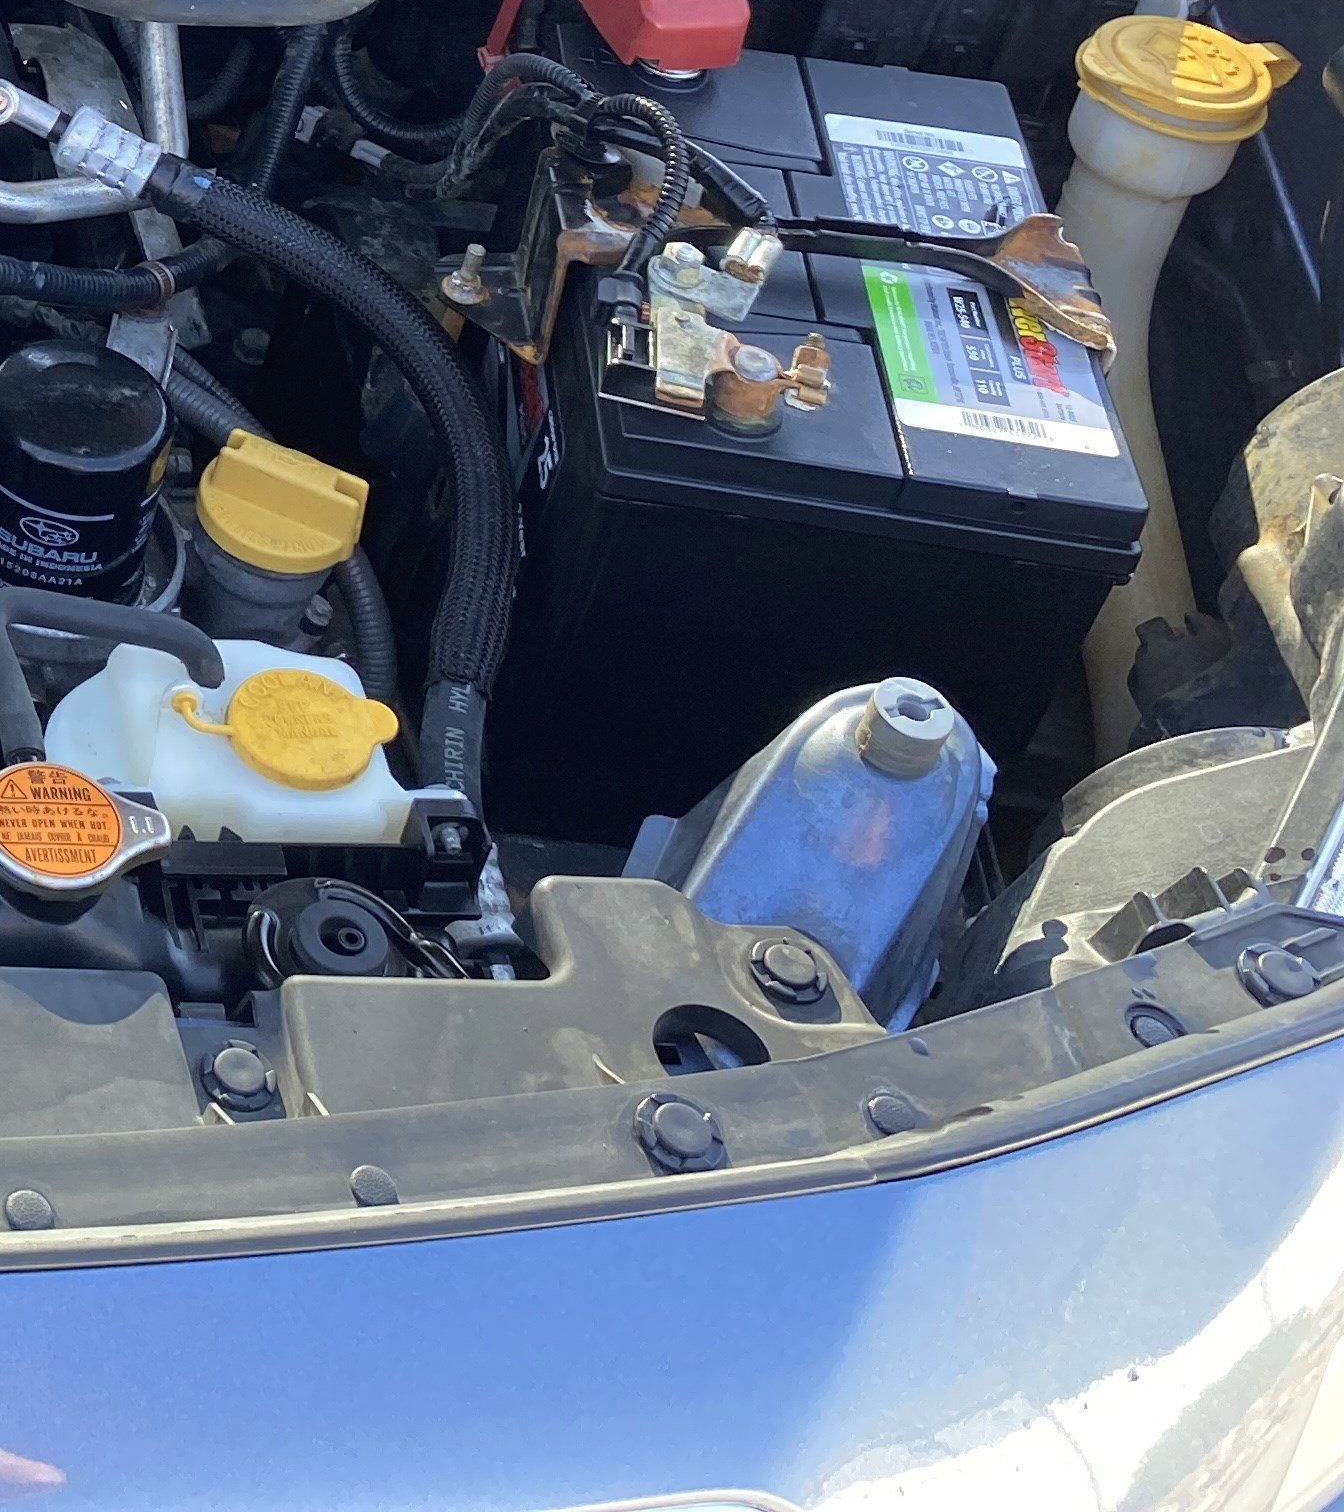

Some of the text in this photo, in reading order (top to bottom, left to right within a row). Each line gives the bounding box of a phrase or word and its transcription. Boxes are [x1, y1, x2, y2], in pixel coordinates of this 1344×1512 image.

[1010, 355, 1027, 381] PLUS
[19, 553, 33, 564] IN
[35, 558, 103, 573] INDONESIA
[27, 769, 68, 785] 警告
[29, 786, 92, 802] WARNING
[31, 819, 56, 829] OPEN
[60, 819, 86, 830] WHEN
[16, 831, 43, 842] JAMAIS
[24, 846, 98, 865] AVERTISSMENT
